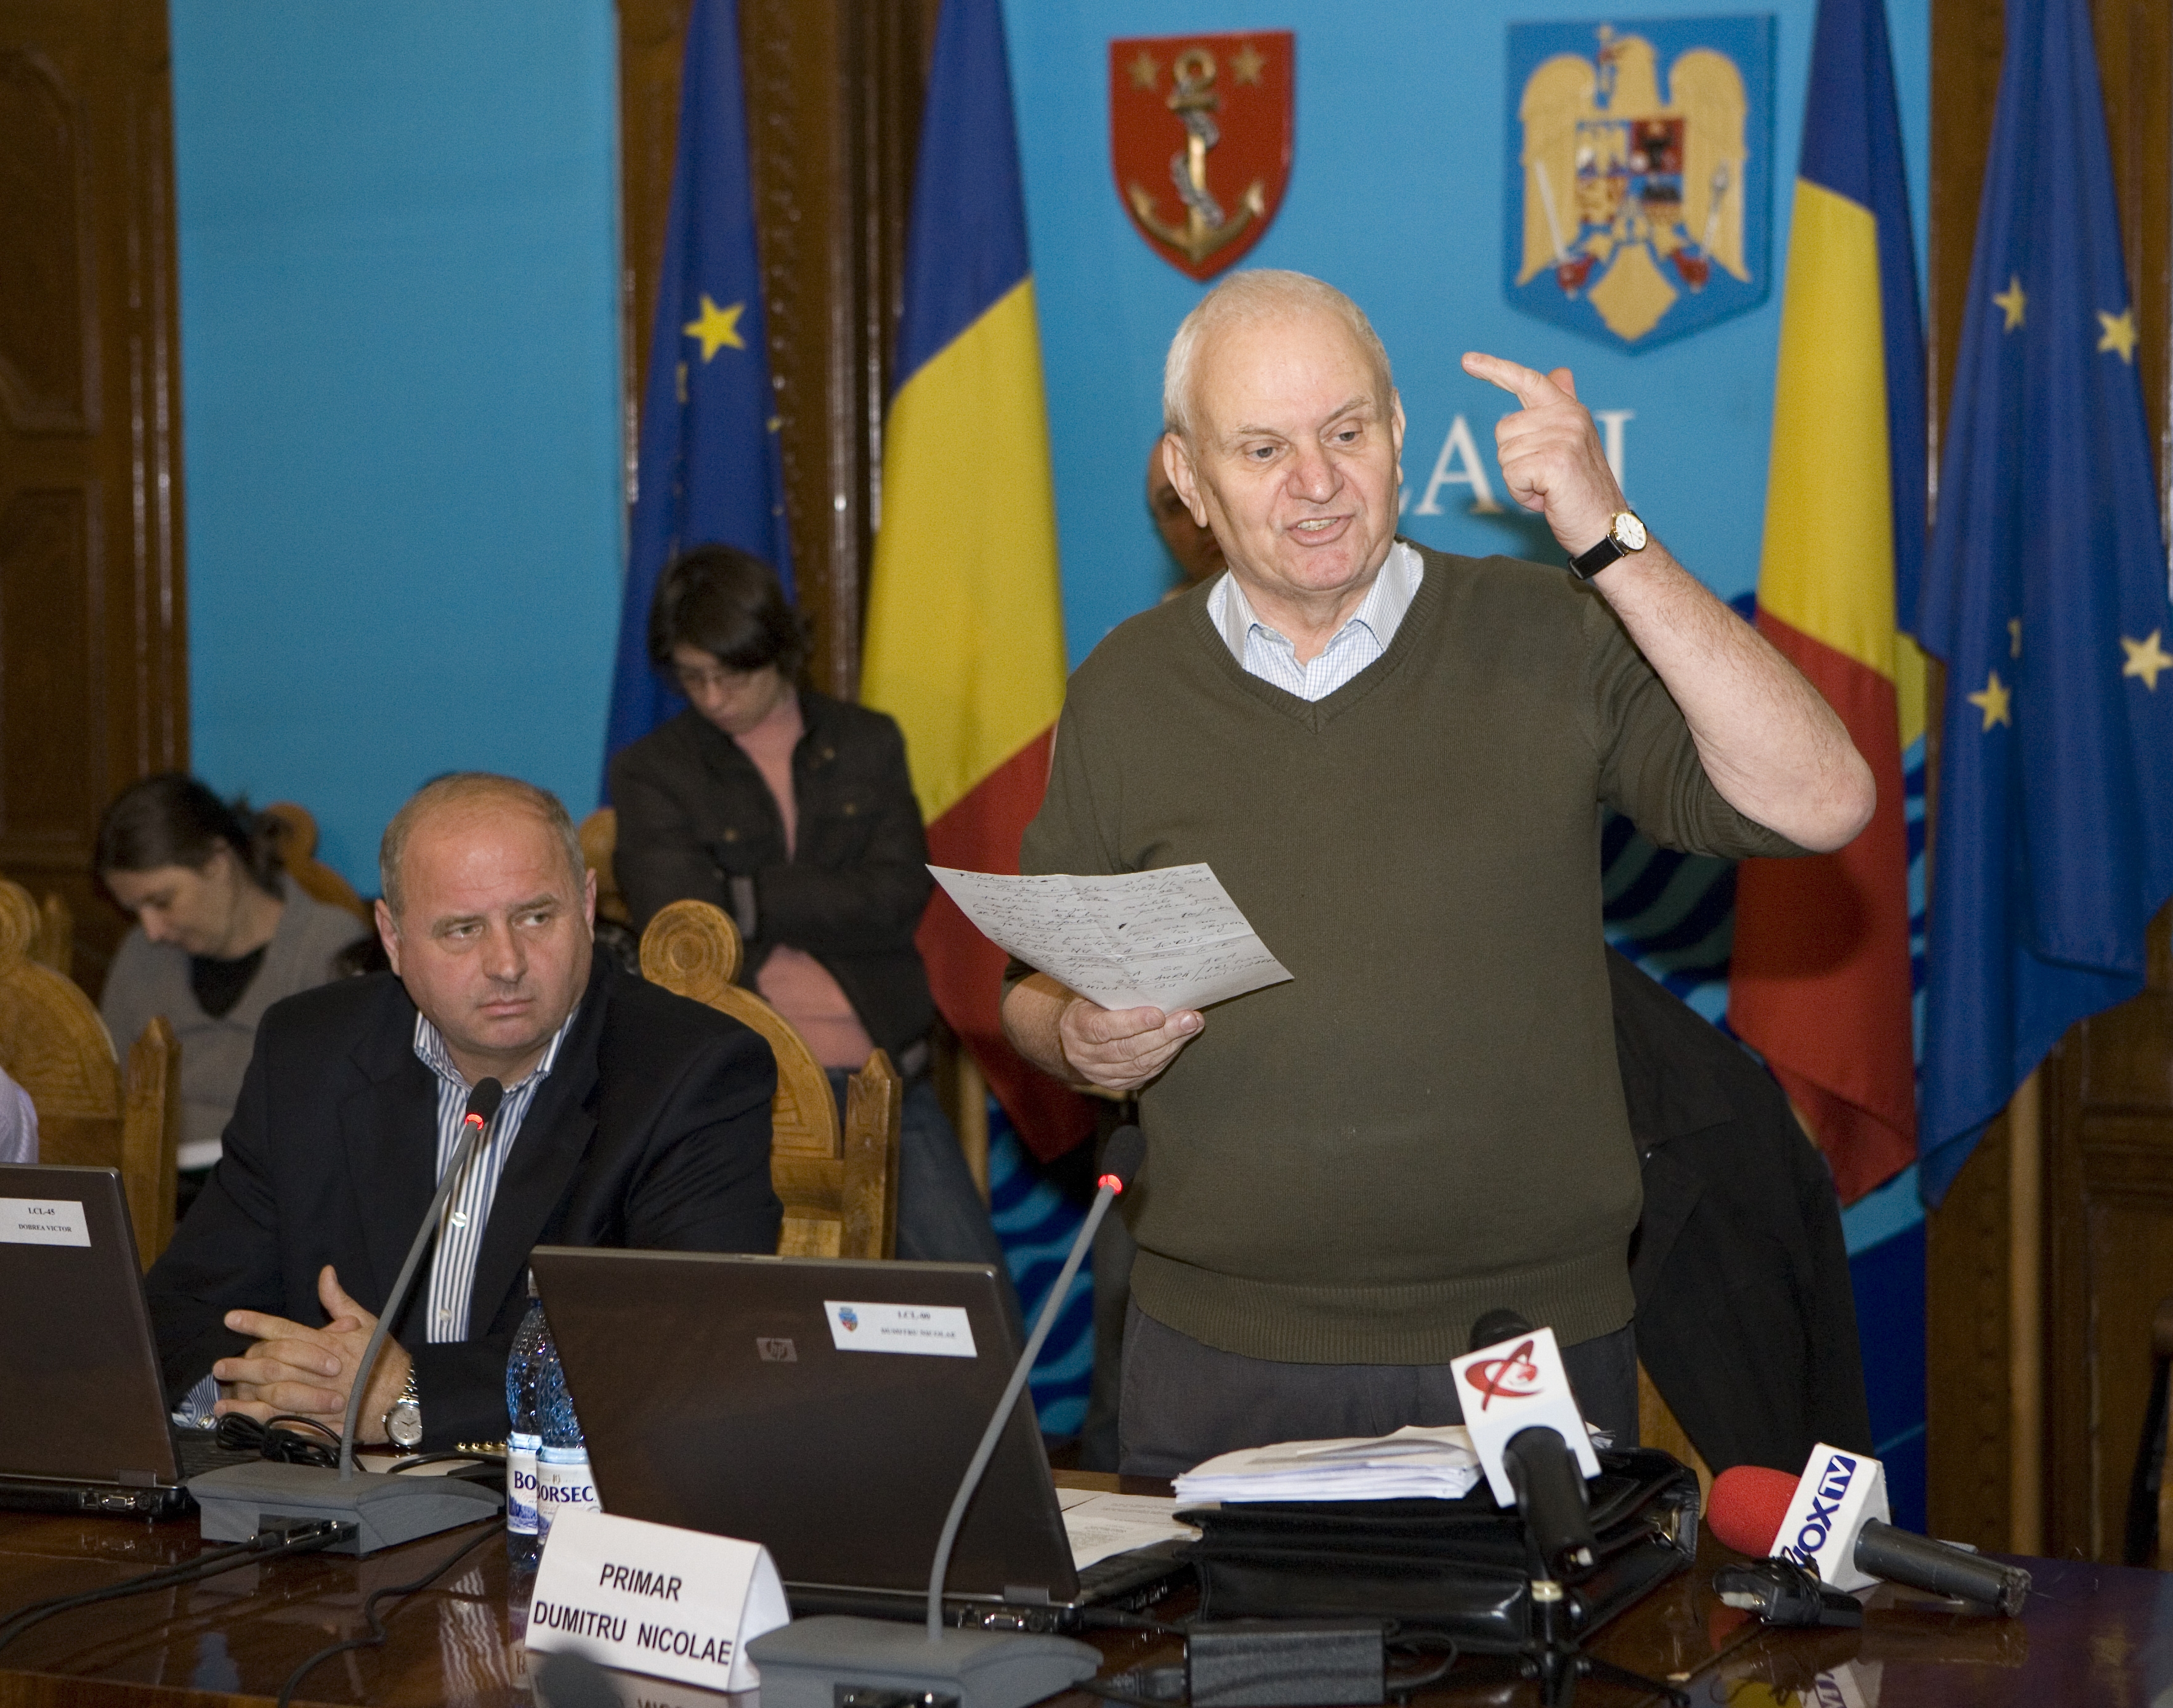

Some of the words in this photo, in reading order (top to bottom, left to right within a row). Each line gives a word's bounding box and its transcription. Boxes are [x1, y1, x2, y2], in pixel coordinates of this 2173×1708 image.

[18, 1223, 46, 1231] DOBREA
[46, 1224, 72, 1232] VICTOR
[599, 1563, 682, 1603] PRIMAR
[533, 1600, 628, 1643] DUMITRU
[637, 1622, 734, 1666] NICOLAE
